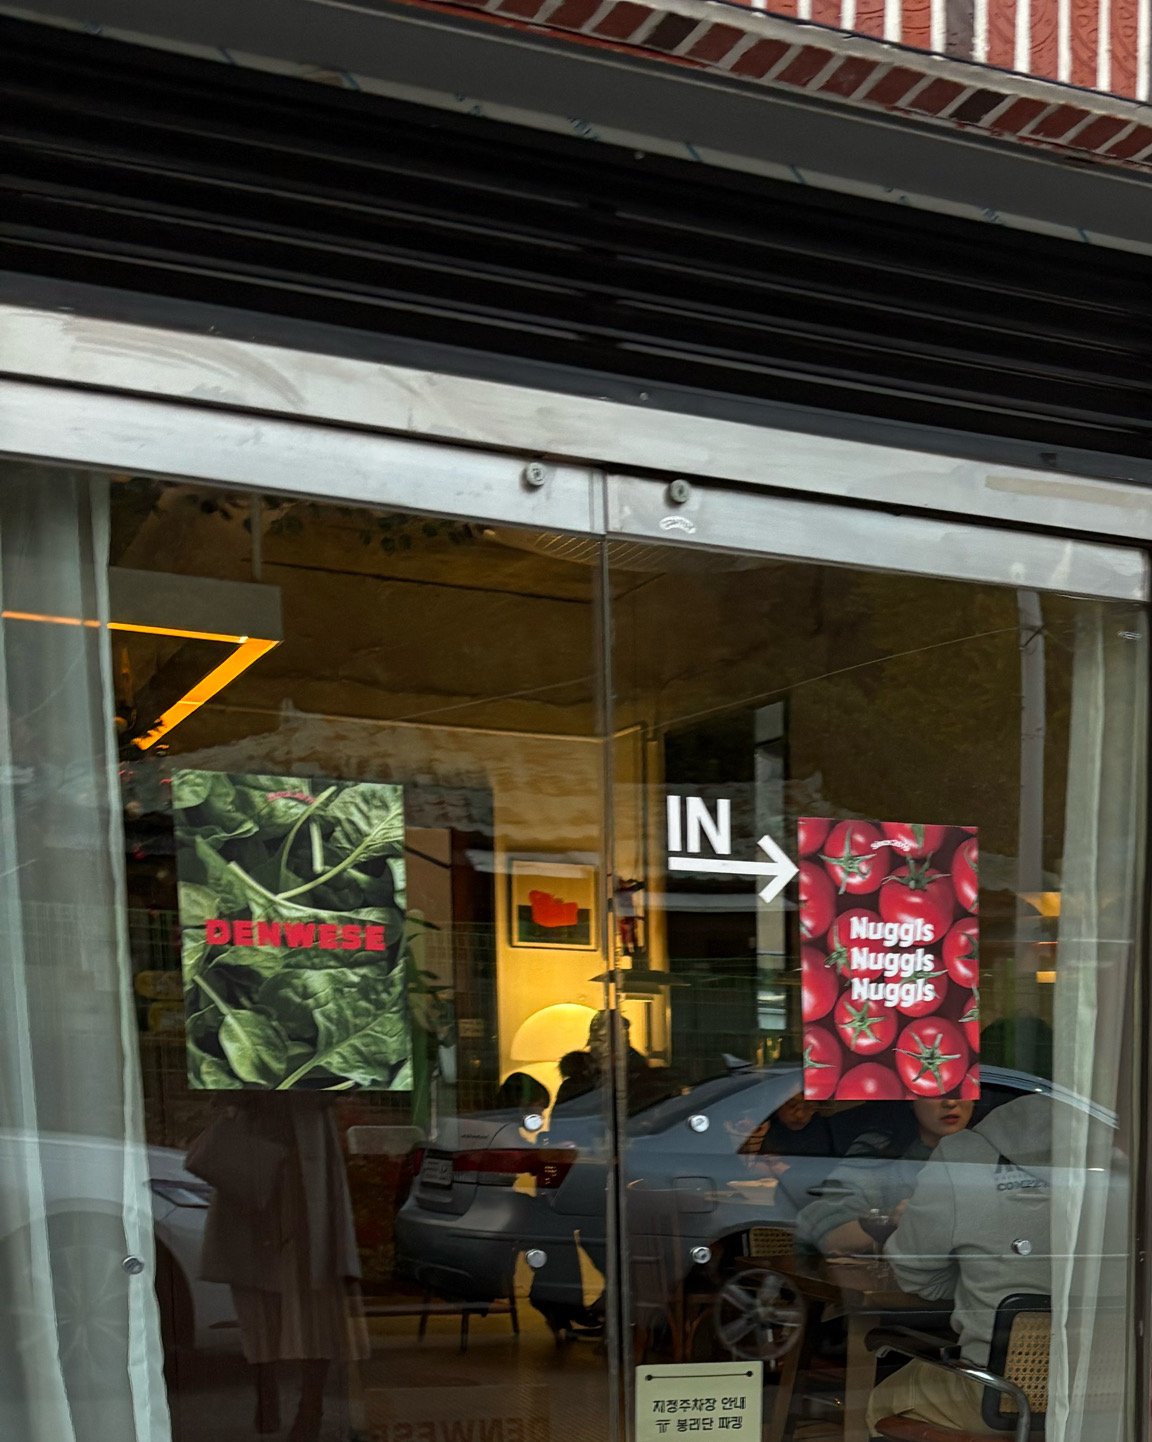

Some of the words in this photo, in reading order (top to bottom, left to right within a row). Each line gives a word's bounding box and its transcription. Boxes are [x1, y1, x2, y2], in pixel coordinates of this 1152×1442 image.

[666, 795, 731, 855] IN
[205, 918, 386, 952] DENWESE
[850, 916, 934, 947] Nuggls
[850, 947, 935, 977] Nuggls
[851, 977, 935, 1007] Nuggls
[653, 1398, 717, 1413] 지정주차장
[721, 1396, 747, 1411] 안내
